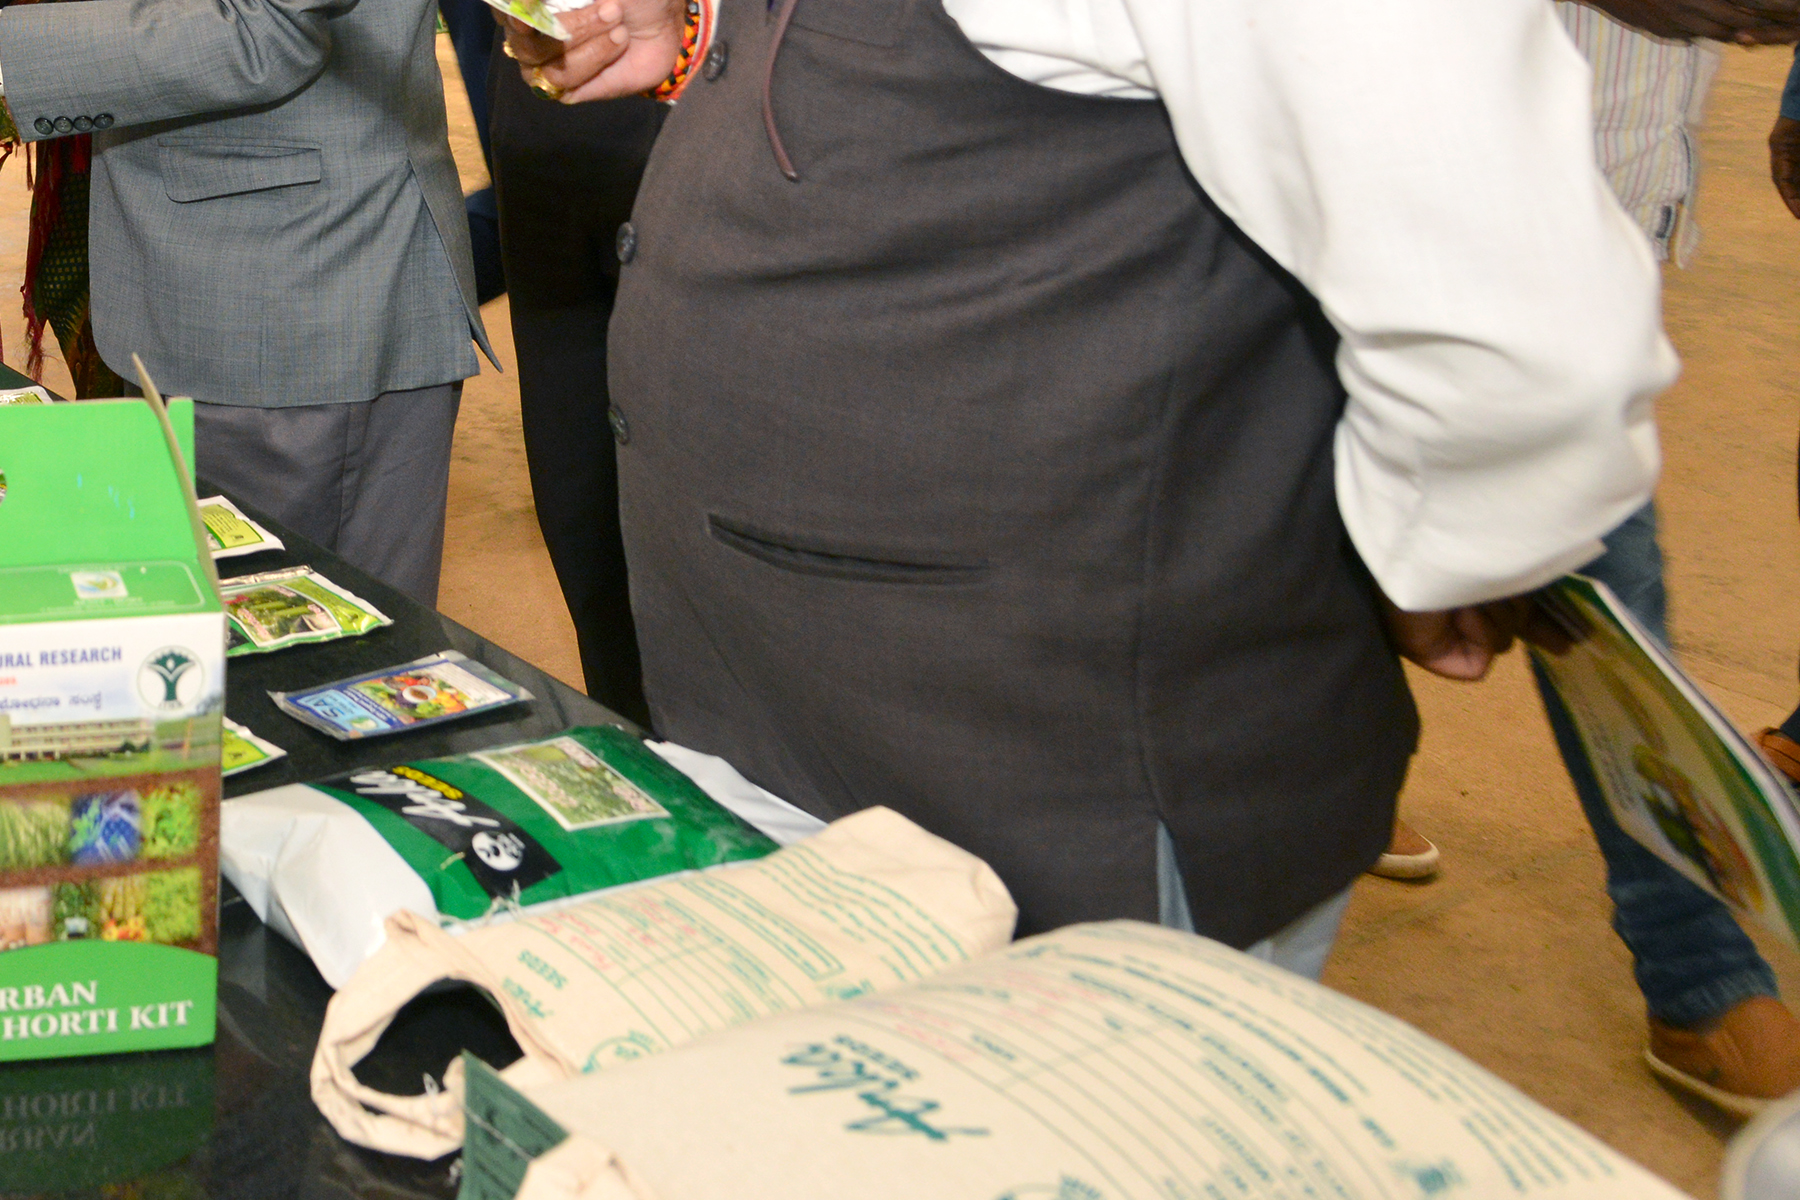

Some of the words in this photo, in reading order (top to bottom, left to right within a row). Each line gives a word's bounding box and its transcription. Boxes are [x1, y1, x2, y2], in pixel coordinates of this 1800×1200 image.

[38, 645, 123, 667] RESEARCH
[348, 765, 501, 829] Arka
[391, 764, 465, 801] SEEDS
[517, 948, 567, 991] SEEDS
[1, 1005, 122, 1042] HORTI
[129, 999, 194, 1030] KIT
